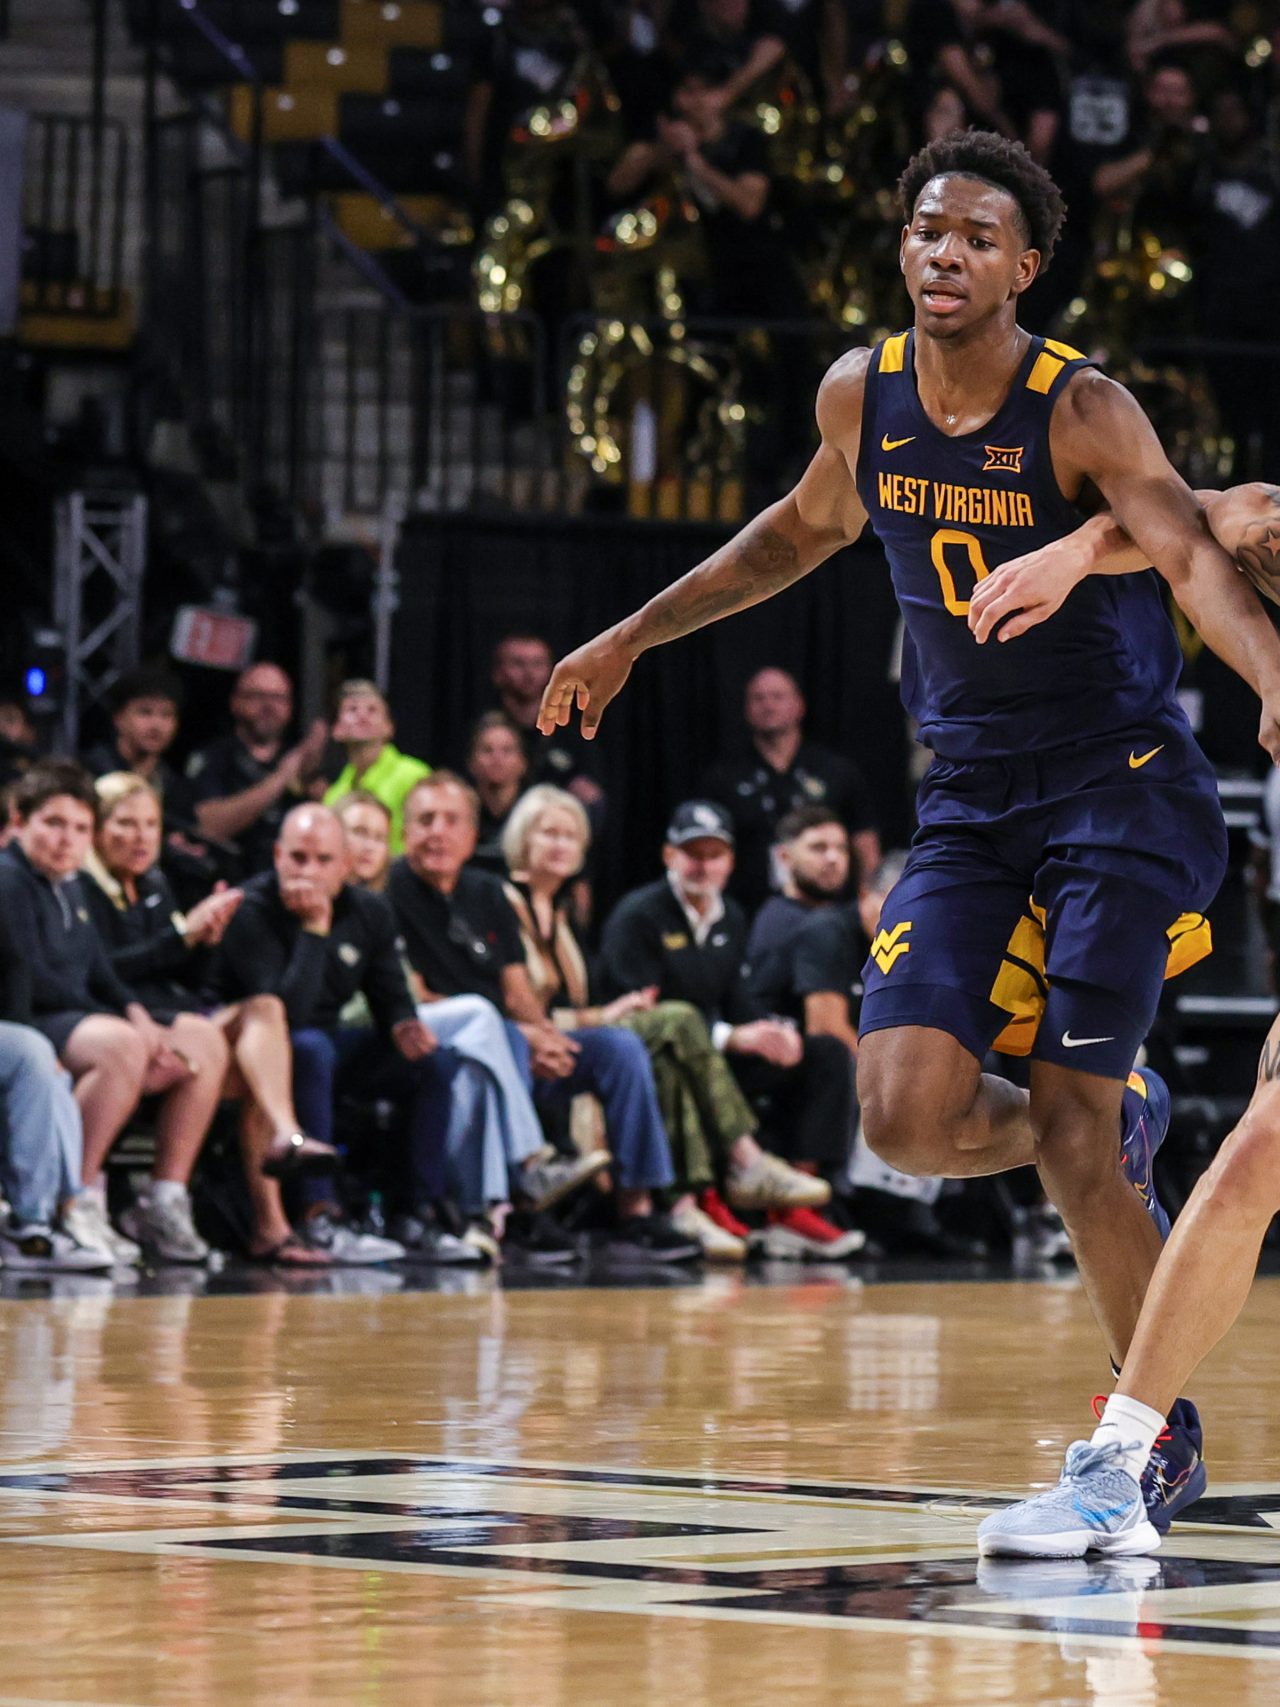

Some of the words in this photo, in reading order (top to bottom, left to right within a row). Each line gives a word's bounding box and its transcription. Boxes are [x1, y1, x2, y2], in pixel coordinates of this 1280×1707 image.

[878, 471, 929, 516] WEST
[933, 482, 1035, 527] VIRGINIA
[931, 528, 990, 616] 0
